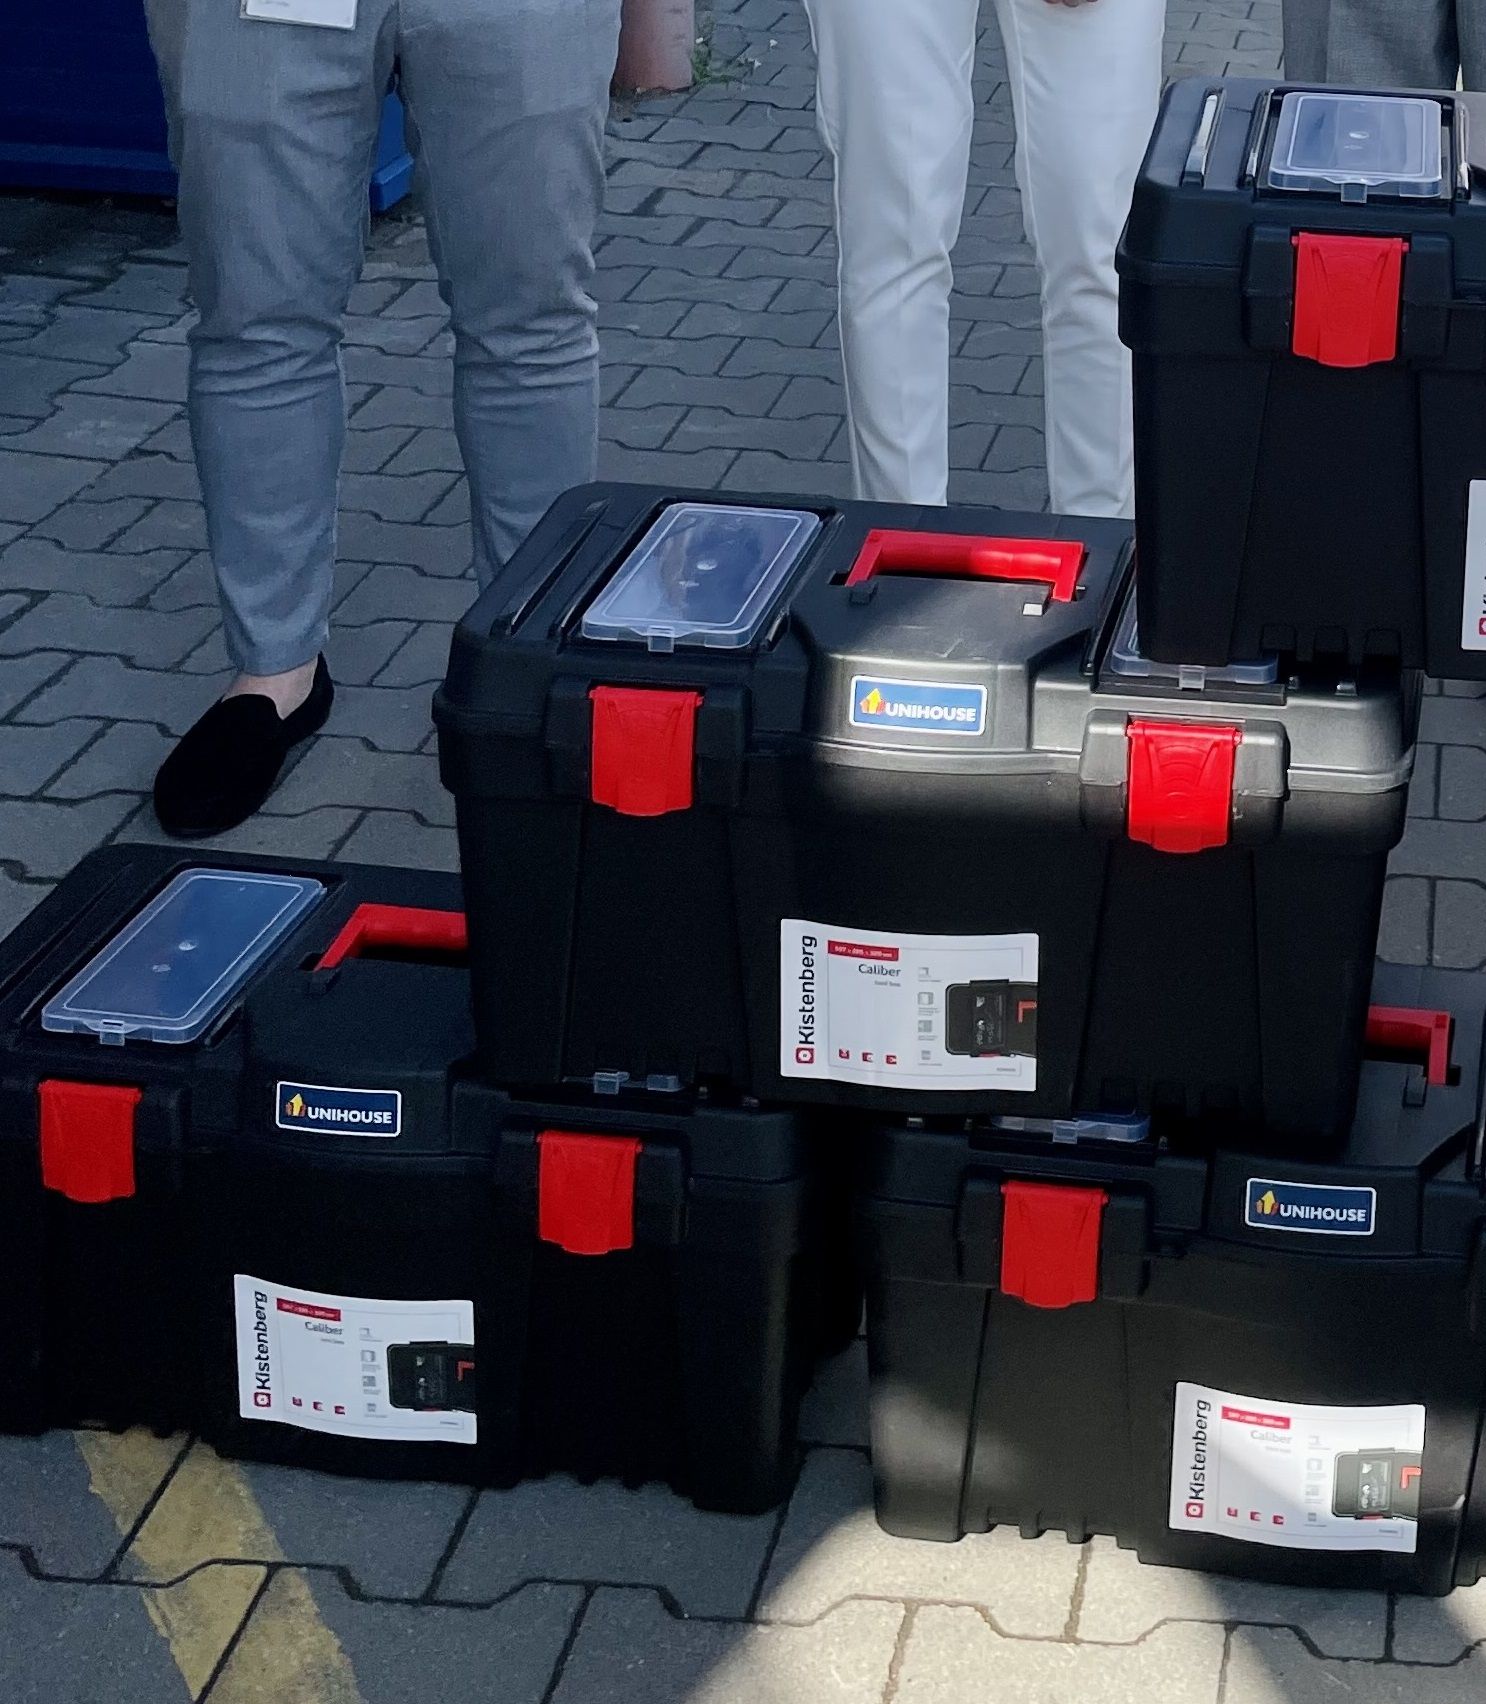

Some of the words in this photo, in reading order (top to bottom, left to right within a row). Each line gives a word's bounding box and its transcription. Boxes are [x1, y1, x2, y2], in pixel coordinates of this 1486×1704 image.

[885, 702, 977, 722] UNIHOUSE
[858, 963, 902, 977] Caliber
[798, 935, 818, 1045] Kistenberg
[307, 1106, 392, 1124] UNIHOUSE
[1279, 1203, 1367, 1222] UNIHOUSE
[254, 1291, 271, 1391] Kistenberg
[1188, 1399, 1211, 1501] Kistenberg
